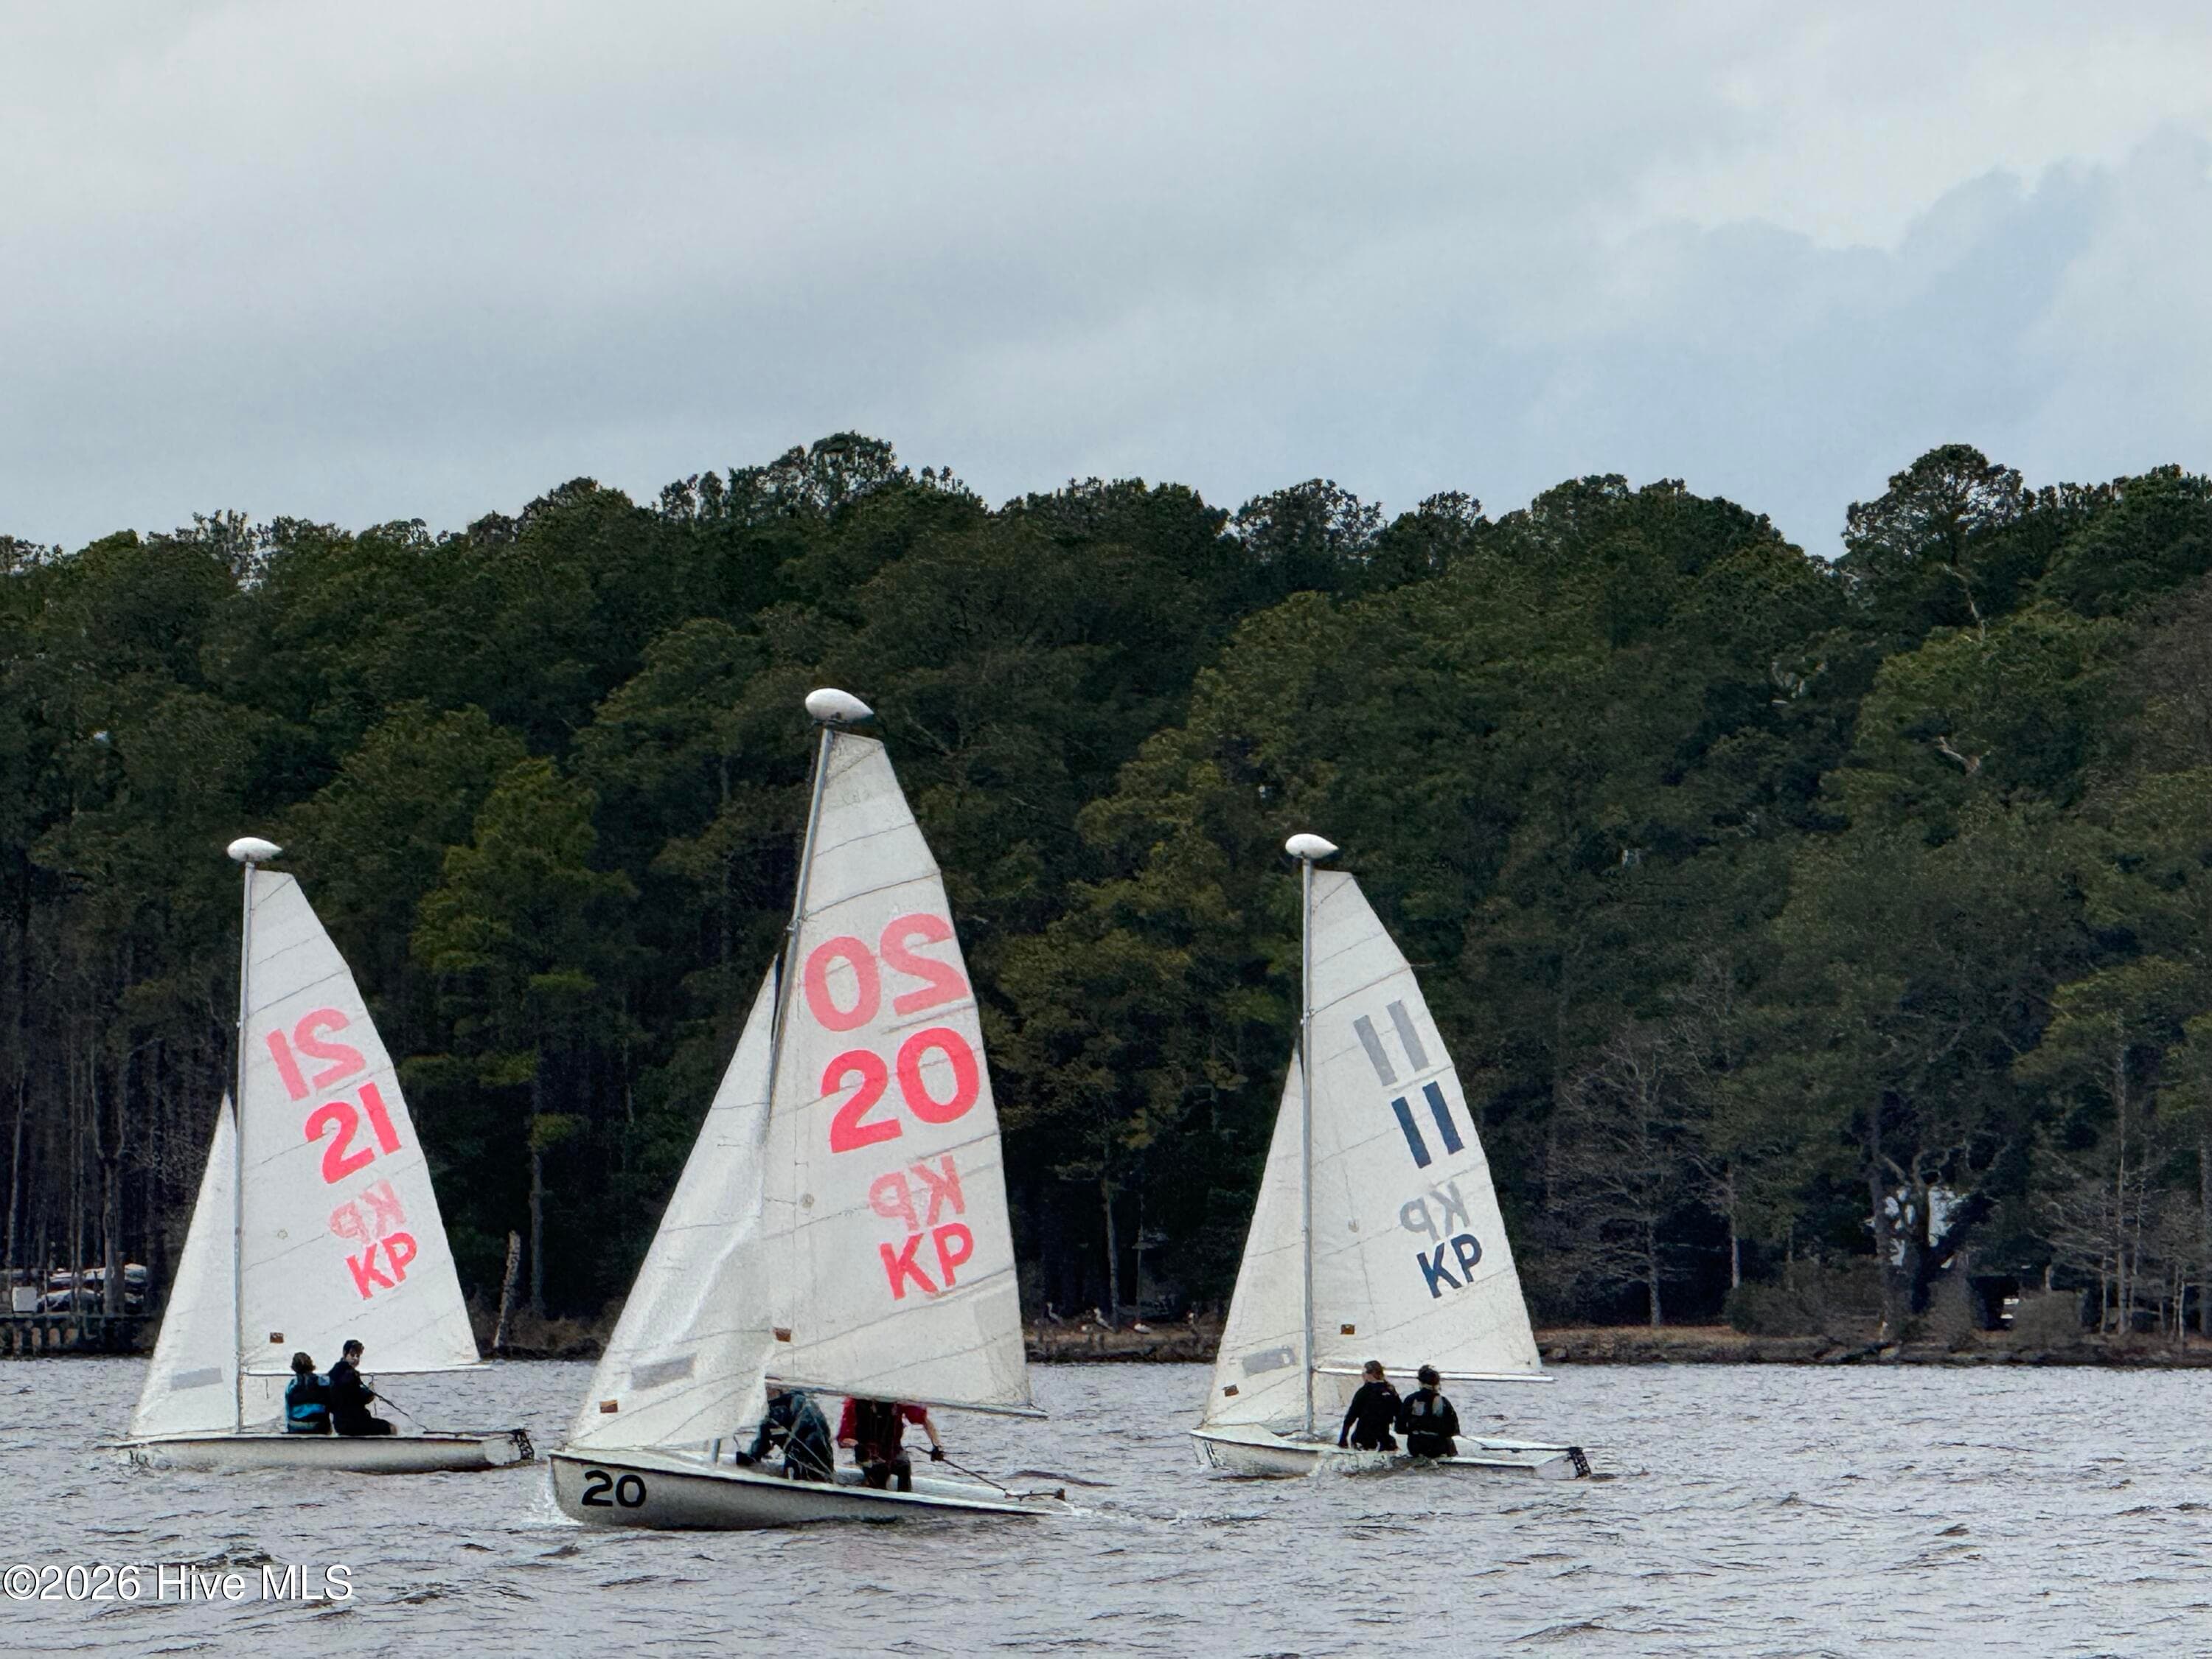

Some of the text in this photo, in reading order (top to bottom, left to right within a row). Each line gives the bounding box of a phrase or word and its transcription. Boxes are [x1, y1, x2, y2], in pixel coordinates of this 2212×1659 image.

[821, 1027, 980, 1154] 20
[1391, 1081, 1464, 1169] 11
[305, 1082, 401, 1184] 21
[346, 1232, 417, 1300] KP
[880, 1222, 975, 1300] KP
[1416, 1233, 1482, 1299] KP
[581, 1469, 647, 1508] 20
